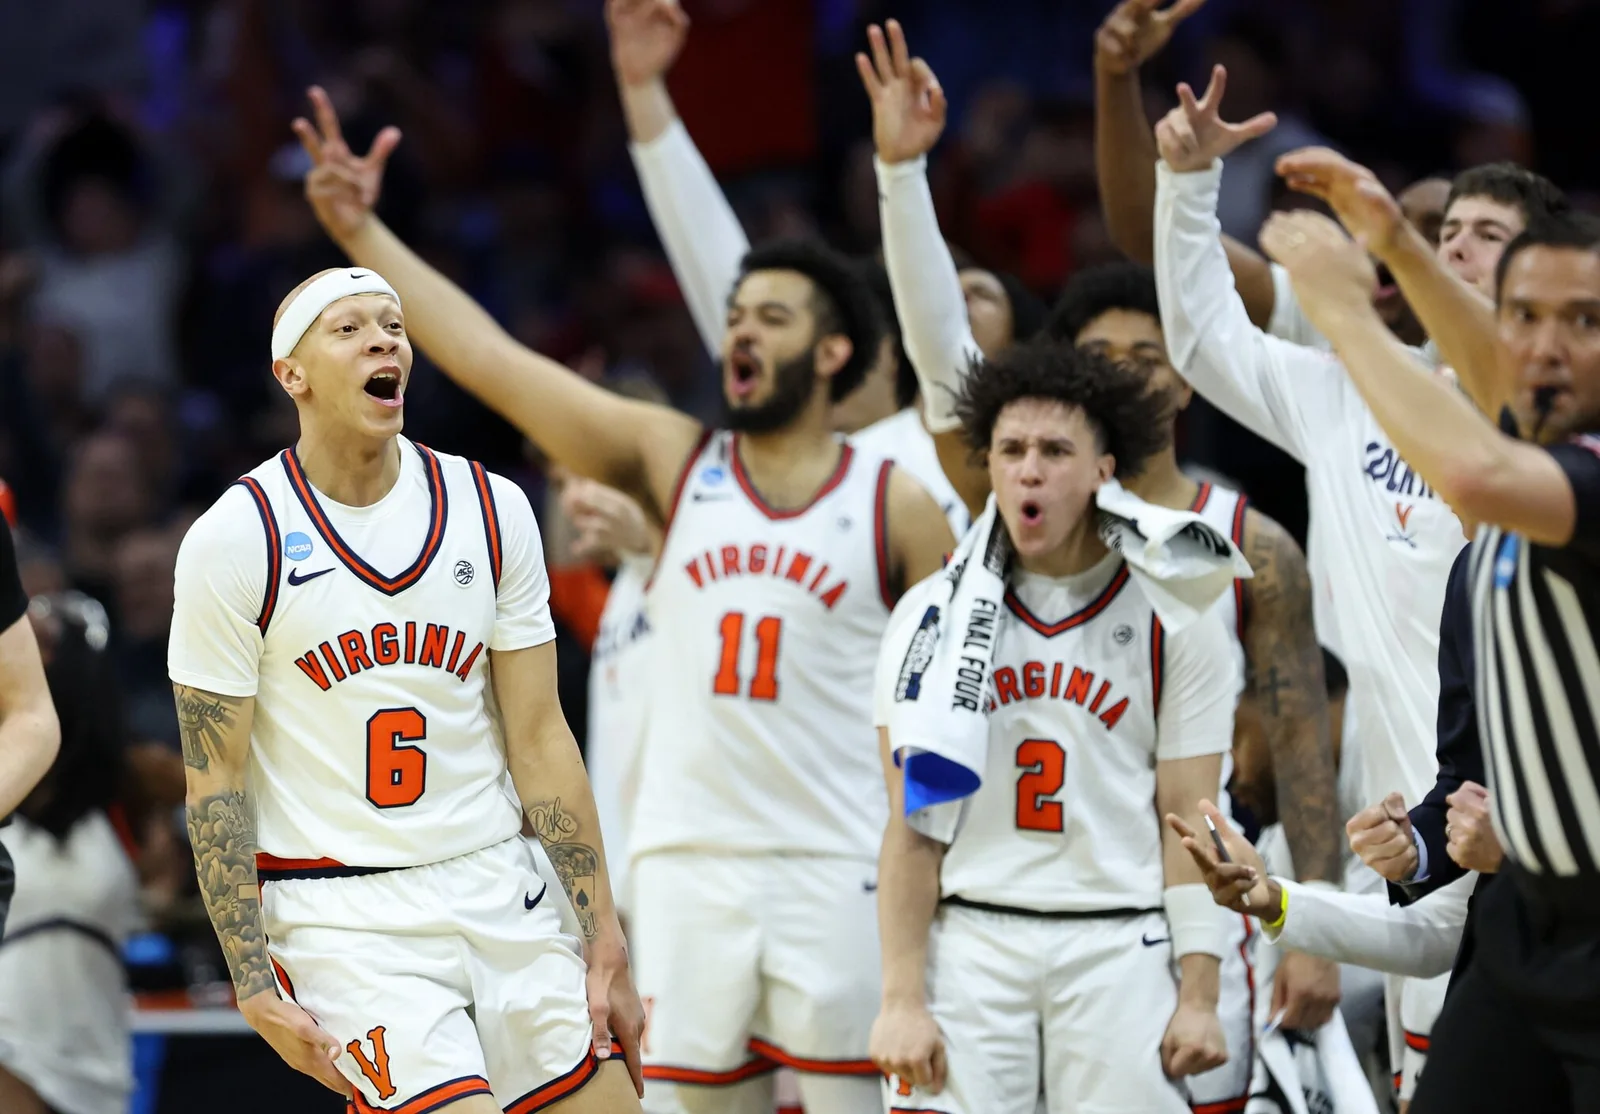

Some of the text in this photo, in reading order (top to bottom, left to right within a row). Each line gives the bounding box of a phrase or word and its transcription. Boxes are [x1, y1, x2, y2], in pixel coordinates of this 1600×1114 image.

[287, 543, 311, 554] NCAA
[685, 544, 848, 612] VIRGINIA
[294, 621, 484, 691] VIRGINIA
[713, 612, 782, 701] 11
[963, 597, 997, 650] FINAL
[952, 656, 985, 713] FOUR
[989, 661, 1131, 731] RGINIA
[366, 706, 427, 809] 6
[1015, 738, 1066, 833] 2
[347, 1025, 396, 1100] V
